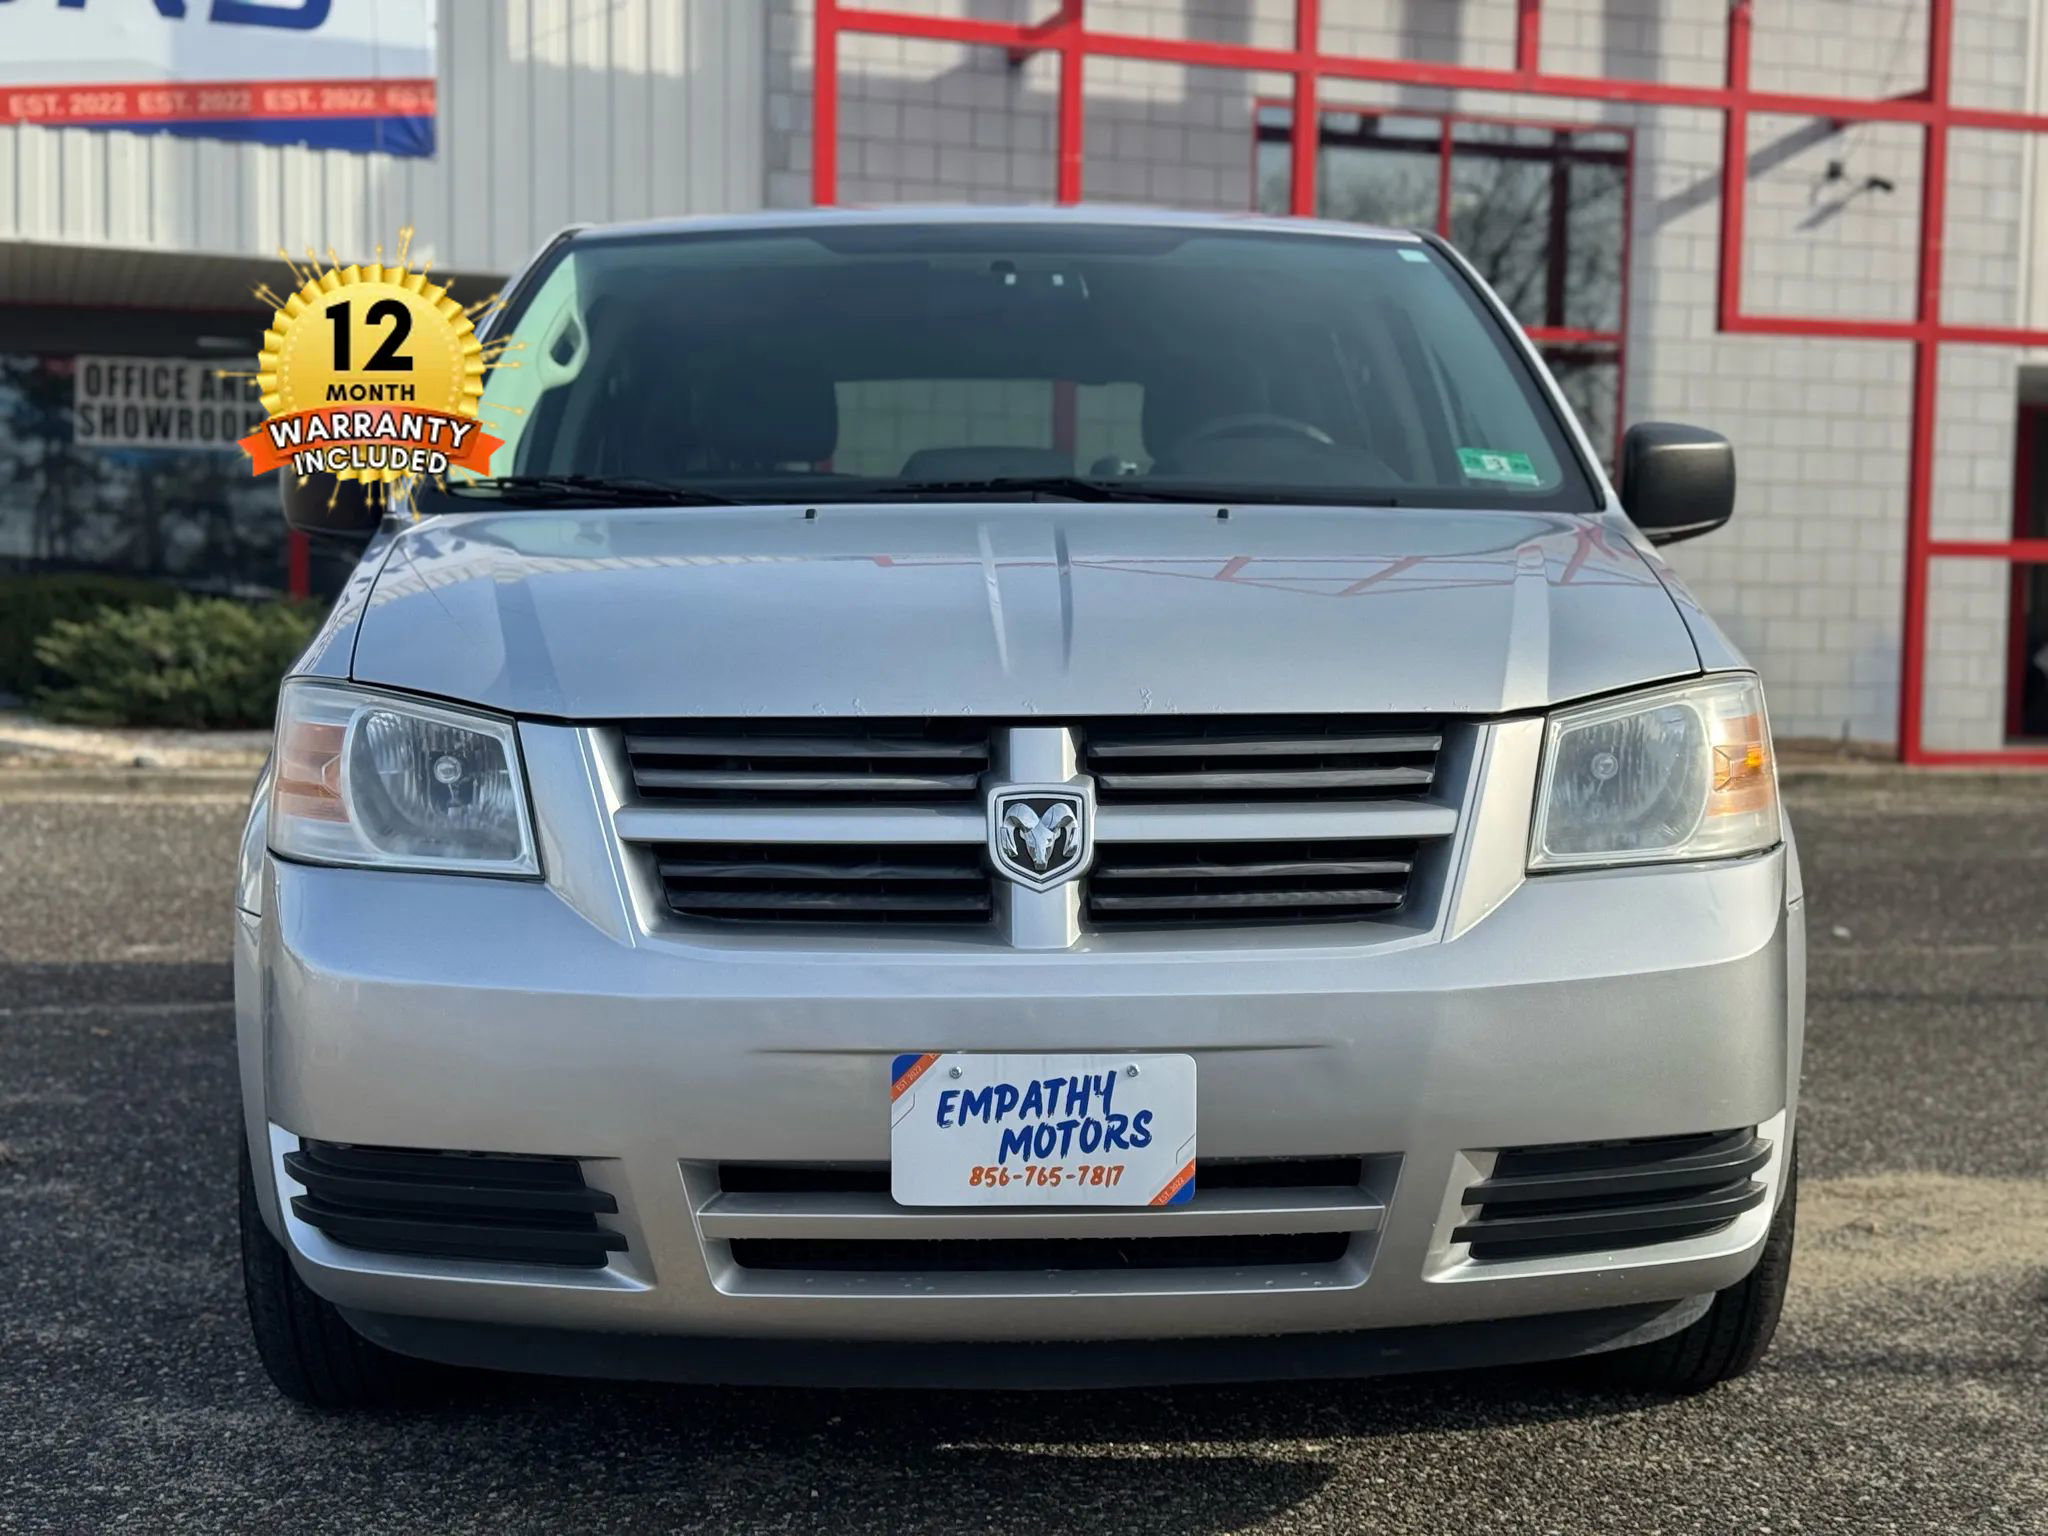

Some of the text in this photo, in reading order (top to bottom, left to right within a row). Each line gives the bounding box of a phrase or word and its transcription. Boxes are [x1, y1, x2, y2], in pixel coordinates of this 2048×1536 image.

[69, 92, 127, 115] 2022
[86, 364, 187, 399] OFFICE
[937, 1070, 1117, 1128] EMPATHY
[998, 1109, 1153, 1165] MOTORS
[969, 1165, 1125, 1188] 856-765-7817
